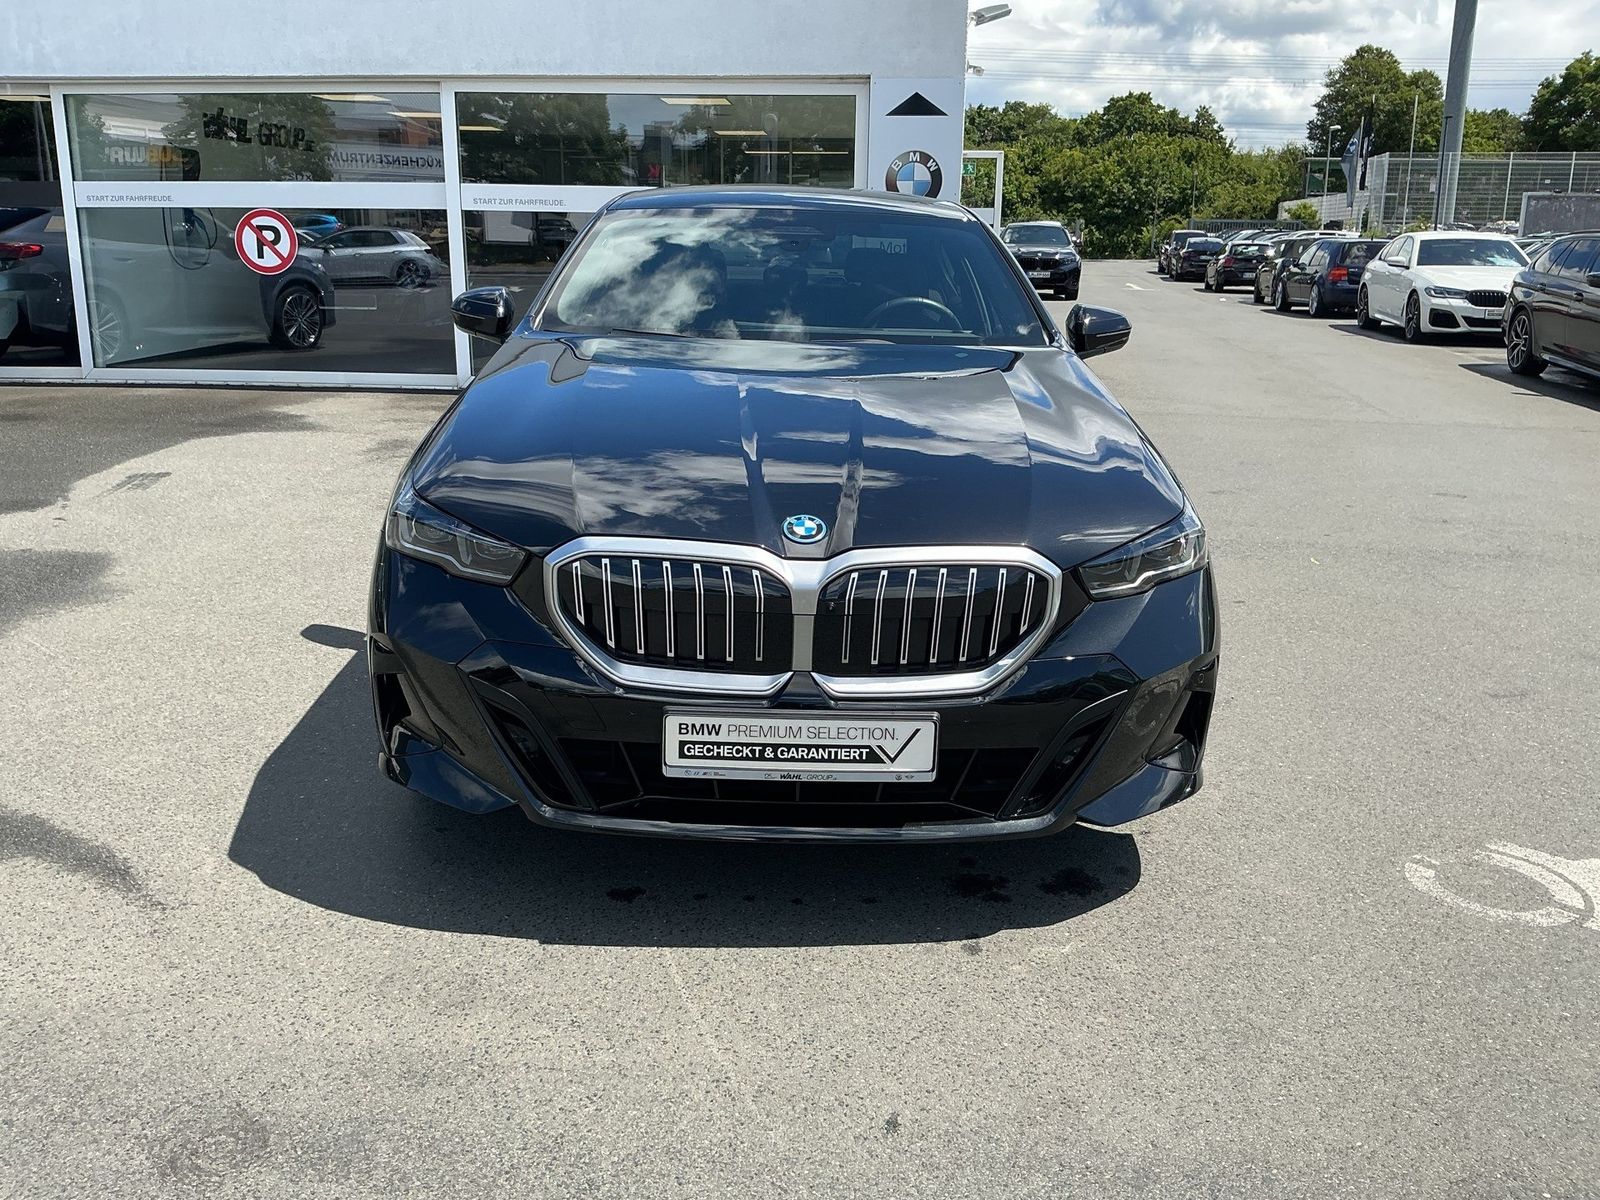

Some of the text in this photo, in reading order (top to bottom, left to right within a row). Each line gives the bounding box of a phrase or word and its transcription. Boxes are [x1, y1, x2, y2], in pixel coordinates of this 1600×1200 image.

[891, 151, 939, 172] BMW
[126, 195, 175, 203] FAHRFREUDE.
[473, 197, 567, 207] START ZUR FAHRFREUDE.
[255, 224, 282, 260] P
[678, 722, 899, 741] BMW PREMIUM SELECTION.
[683, 743, 870, 760] GECHECKT & GARANTIERT
